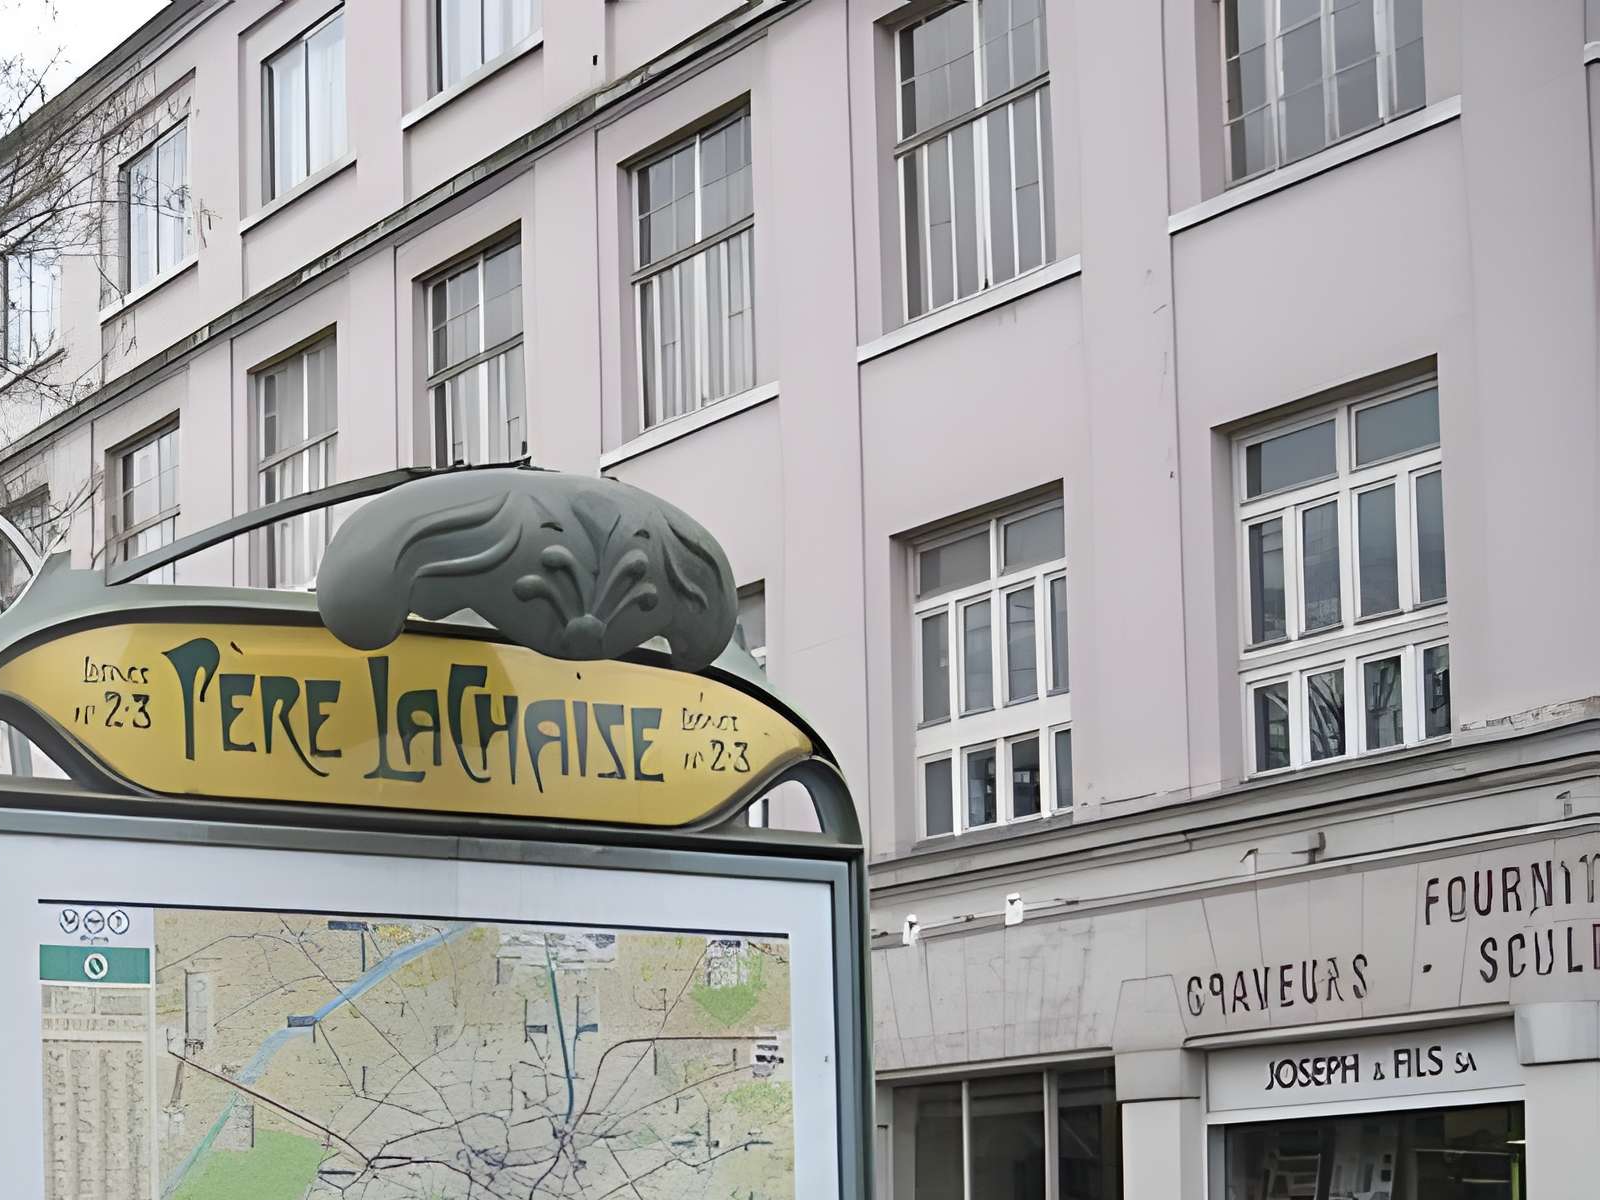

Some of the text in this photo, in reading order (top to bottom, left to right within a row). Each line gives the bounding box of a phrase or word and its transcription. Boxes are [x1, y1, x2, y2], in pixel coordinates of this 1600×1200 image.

[161, 637, 343, 778] PÈRE
[1265, 1053, 1360, 1091] JOSEPH
[1393, 1045, 1443, 1080] FILS
